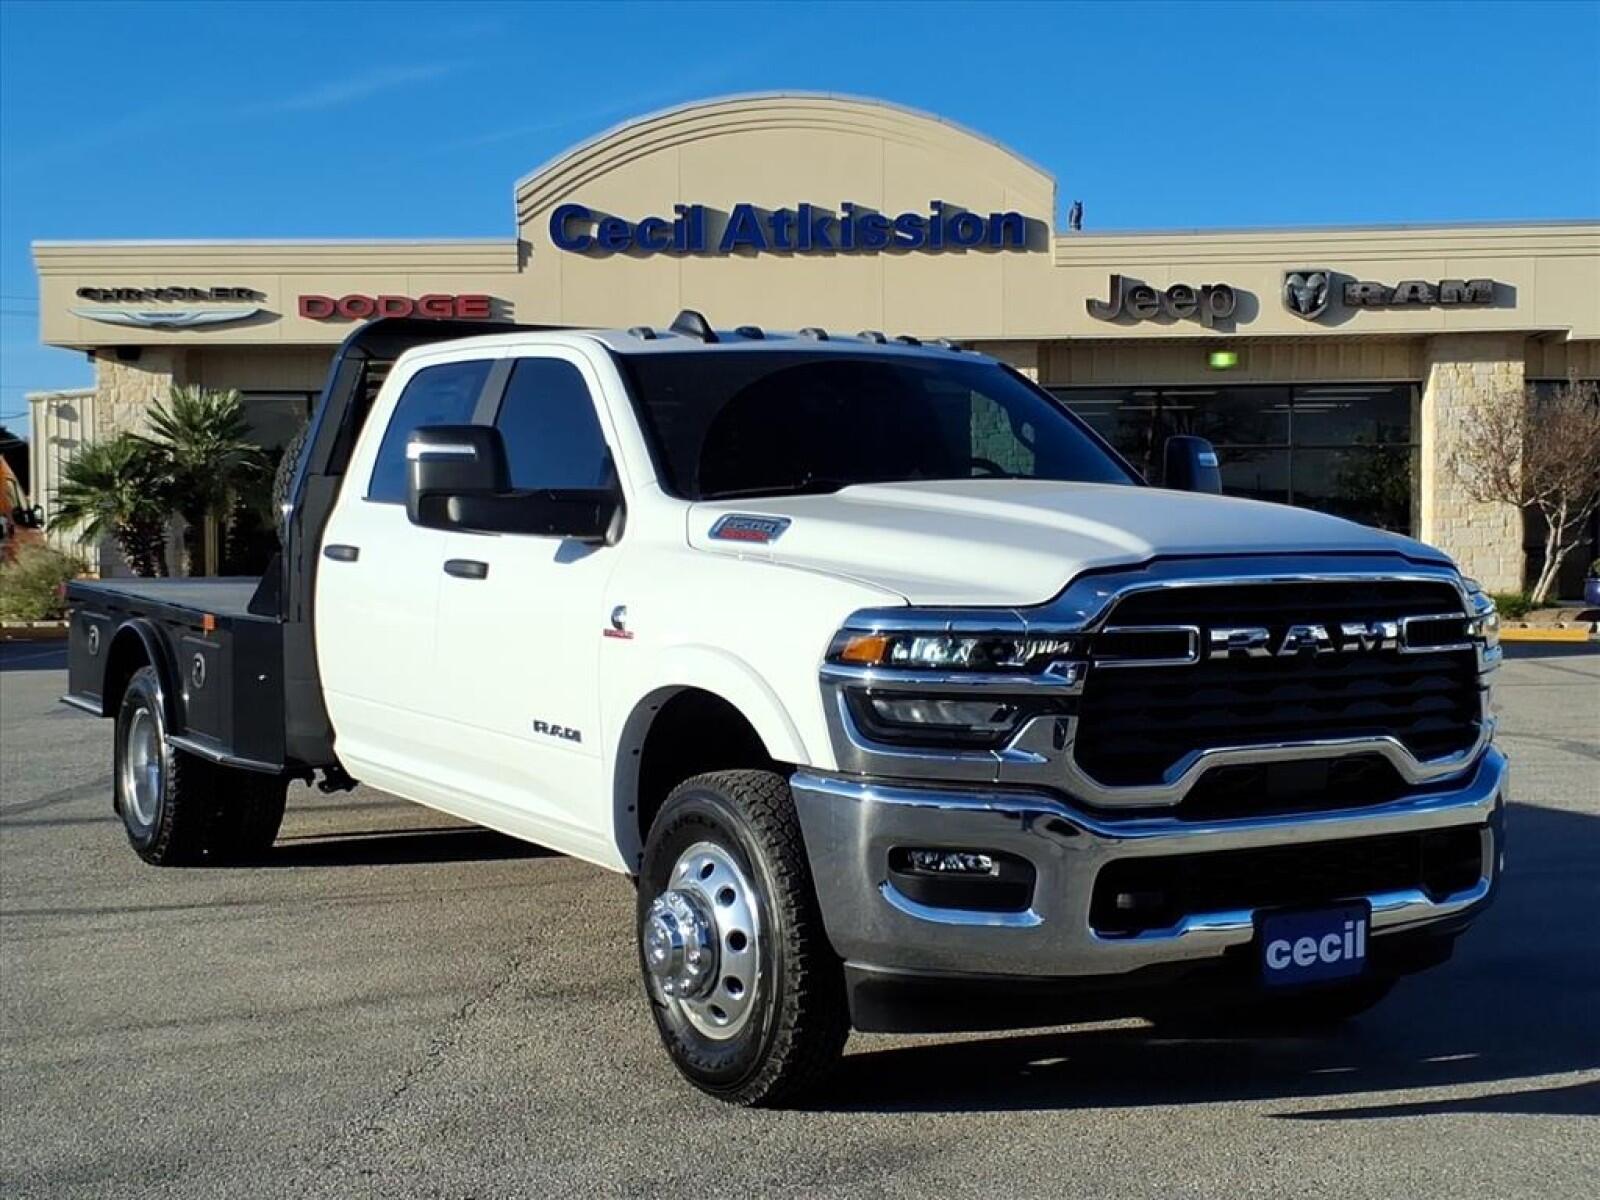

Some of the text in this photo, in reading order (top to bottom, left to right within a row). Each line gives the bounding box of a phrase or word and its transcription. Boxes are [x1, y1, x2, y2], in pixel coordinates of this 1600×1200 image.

[548, 200, 1027, 252] Cecil Atkission
[76, 287, 256, 302] CHRYSLER
[298, 294, 493, 319] DODGE
[1086, 274, 1237, 328] Jeep
[1344, 279, 1494, 306] RAM
[1208, 621, 1398, 659] RAM
[533, 720, 582, 743] RAM
[1266, 919, 1365, 970] cecil
